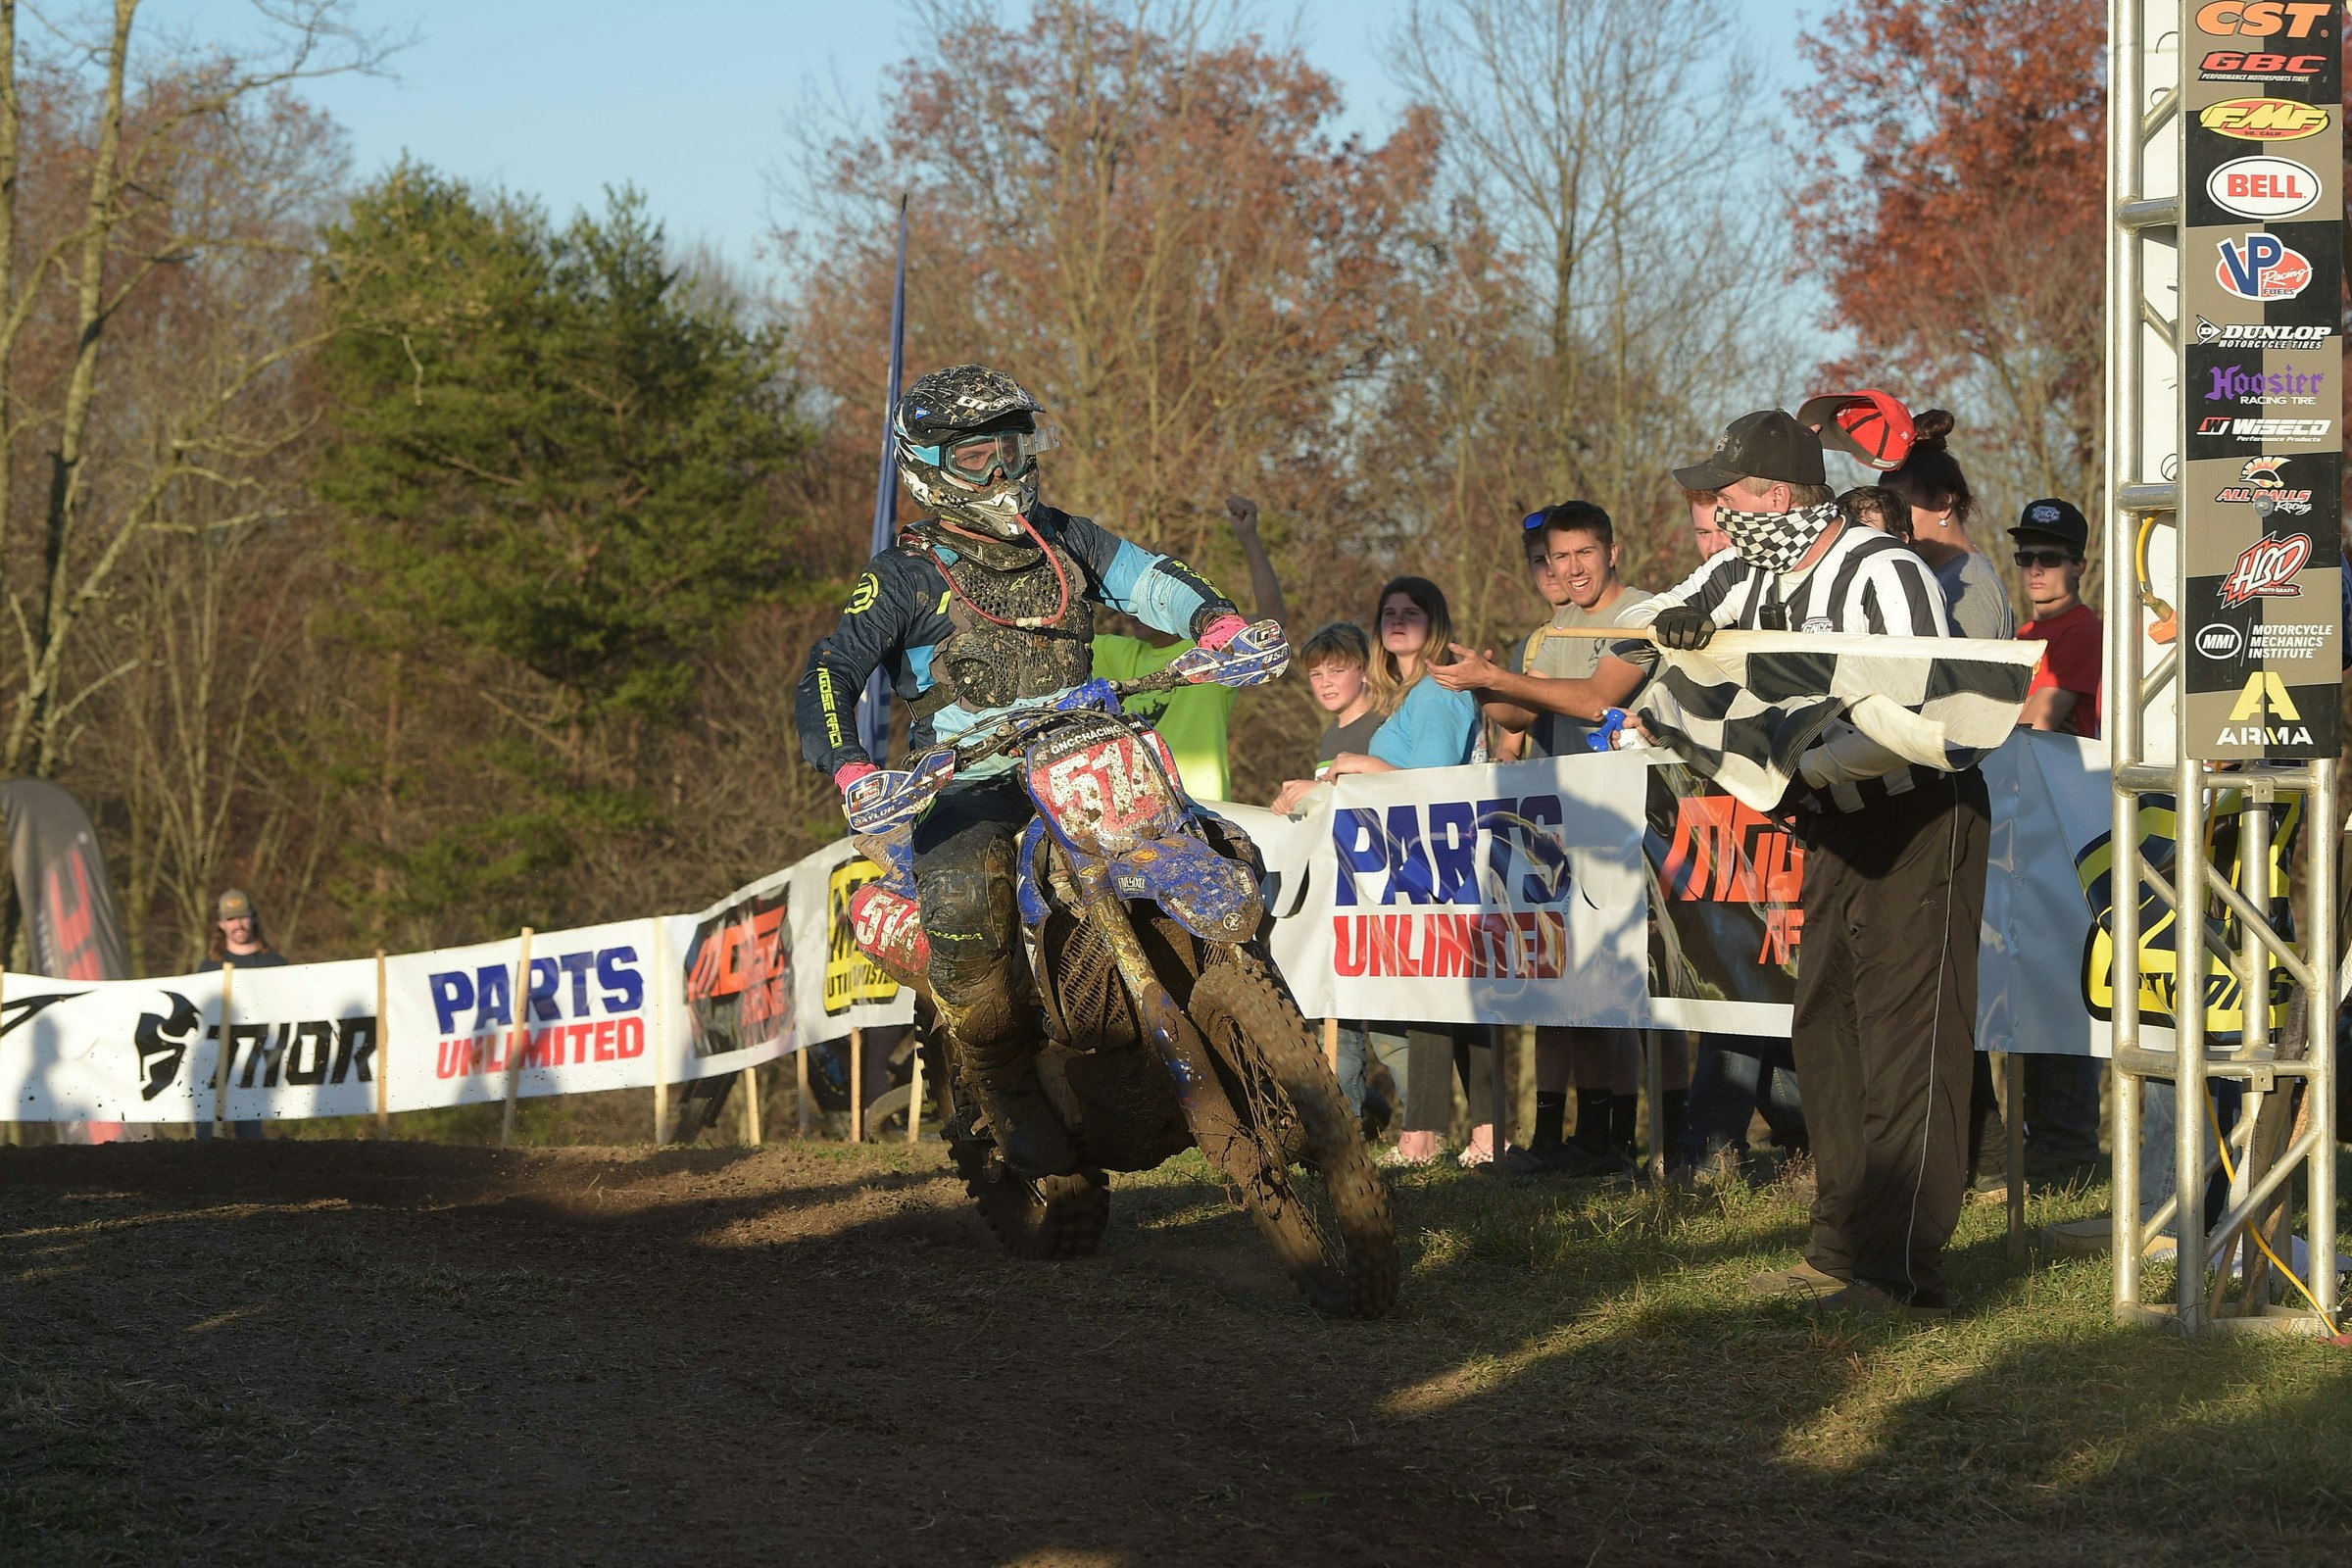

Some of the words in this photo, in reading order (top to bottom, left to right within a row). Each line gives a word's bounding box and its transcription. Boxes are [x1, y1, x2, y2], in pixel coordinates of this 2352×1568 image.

[2196, 0, 2331, 38] CST
[2201, 52, 2328, 74] GBC
[2201, 103, 2328, 130] FMF
[2228, 173, 2303, 199] BELL
[2220, 236, 2282, 297] VP
[2262, 267, 2314, 287] Racing
[2222, 324, 2332, 340] DUNLOP
[2218, 339, 2286, 349] MOTORCYCLE
[2291, 341, 2323, 350] TIRES
[2204, 364, 2325, 401] Hoosier
[2240, 396, 2287, 405] RACING
[2290, 396, 2317, 405] TIRE
[2216, 488, 2251, 502] ALL
[2274, 502, 2313, 515] Racing
[2231, 540, 2305, 594] HBD
[2202, 634, 2235, 649] MMI
[2250, 636, 2324, 647] MECHANICS
[2252, 624, 2333, 636] MOTORCYCLE
[2248, 648, 2315, 659] INSTITUTE
[1051, 720, 1143, 755] GNCCRACING.OM
[2216, 726, 2314, 746] ARMA
[1333, 794, 1571, 906] PARTS
[1333, 911, 1567, 979] UNLIMITED
[428, 946, 644, 1035] PARTS
[207, 1016, 377, 1089] THOR
[436, 1016, 645, 1079] UNLIMITED
